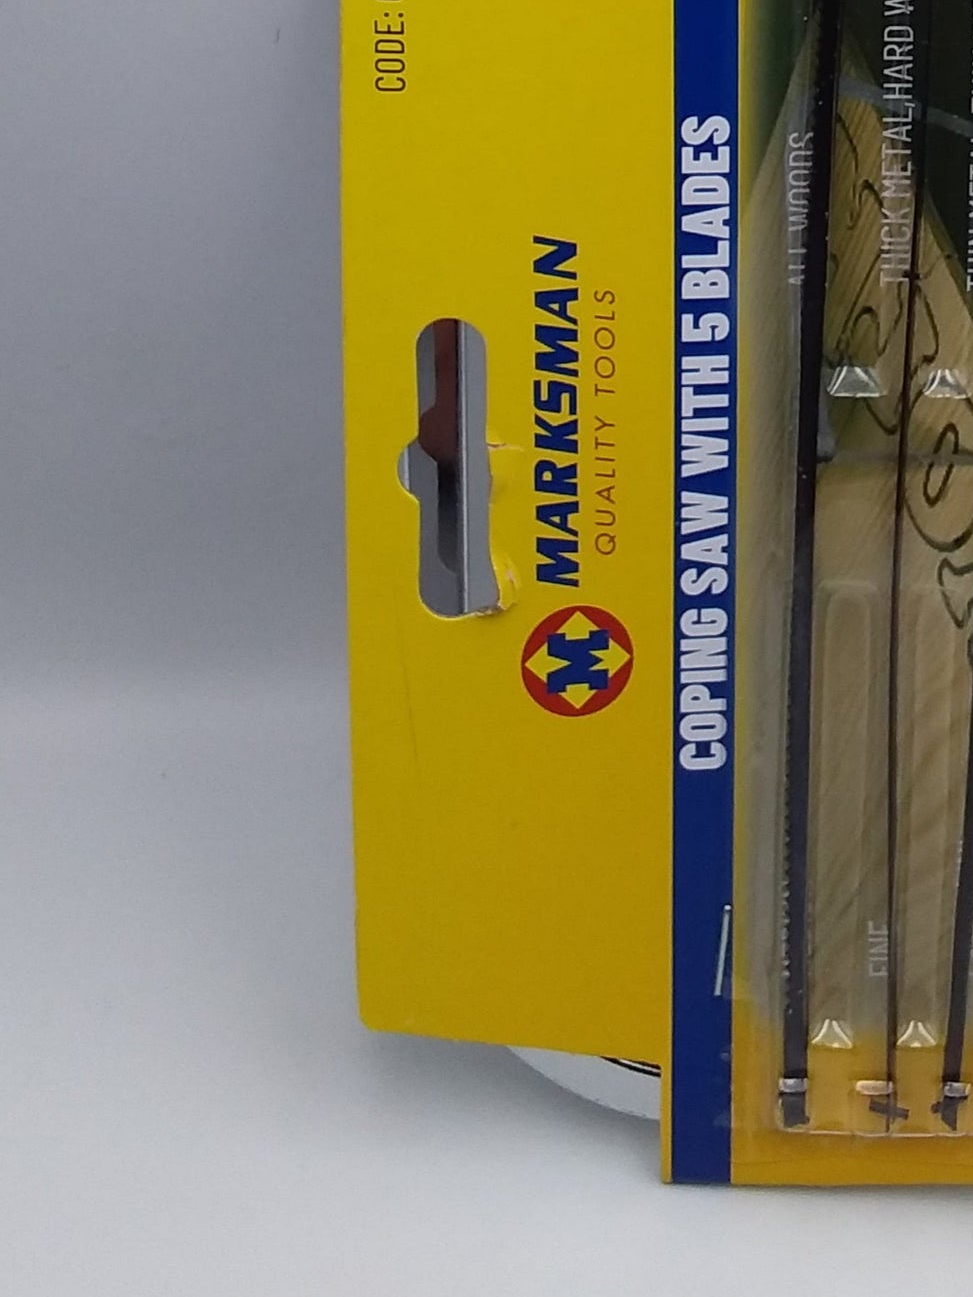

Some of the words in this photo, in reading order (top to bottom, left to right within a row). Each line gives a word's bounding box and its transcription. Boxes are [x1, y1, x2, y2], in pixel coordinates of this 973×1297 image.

[374, 11, 406, 93] CODE:
[680, 115, 731, 299] BLADES
[880, 207, 912, 286] THICK
[594, 289, 616, 395] TOOLS
[681, 312, 730, 341] 5
[533, 236, 579, 588] MARKSMAN
[681, 355, 731, 477] WITH
[595, 416, 617, 556] QUALITY
[680, 492, 730, 595] SAW
[679, 607, 728, 771] COPING
